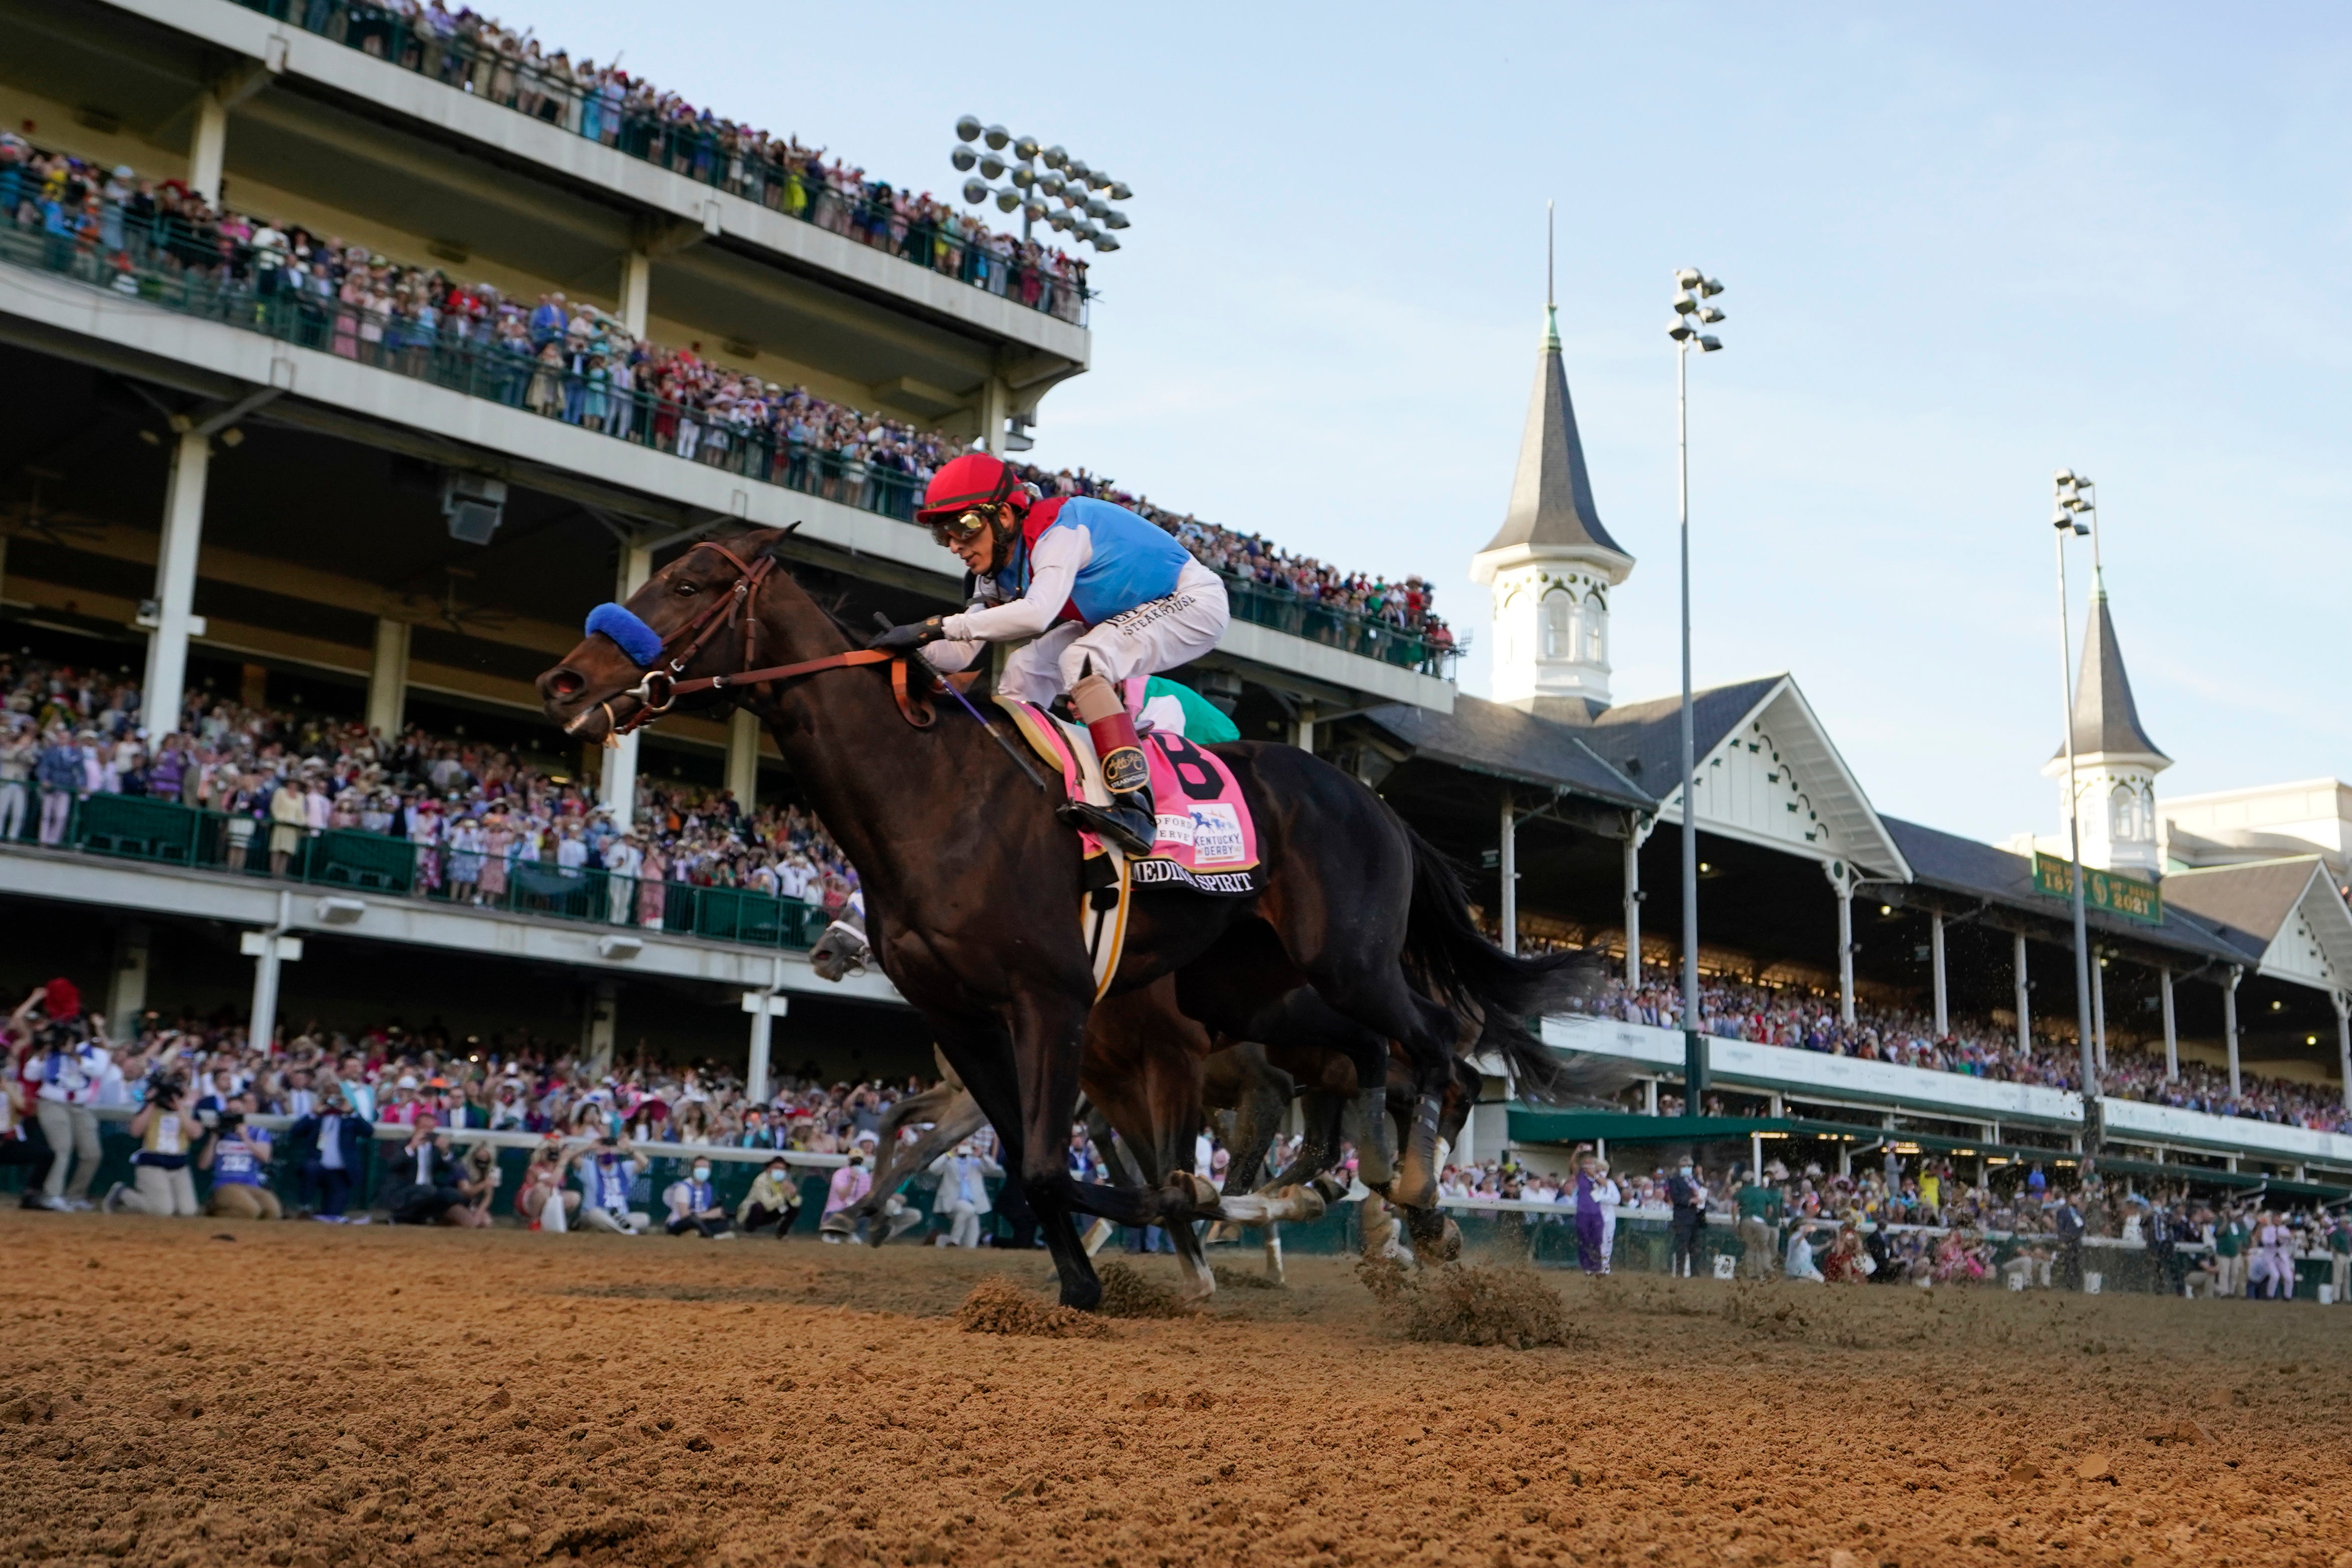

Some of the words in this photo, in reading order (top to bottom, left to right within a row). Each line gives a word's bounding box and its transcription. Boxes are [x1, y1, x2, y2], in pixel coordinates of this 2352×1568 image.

[1150, 733, 1225, 800] 8
[1194, 833, 1240, 846] KENTUCKY
[1204, 845, 1233, 856] DERBY
[1194, 873, 1253, 892] SPIRIT
[2045, 873, 2085, 896] 187
[2113, 892, 2150, 916] 2021
